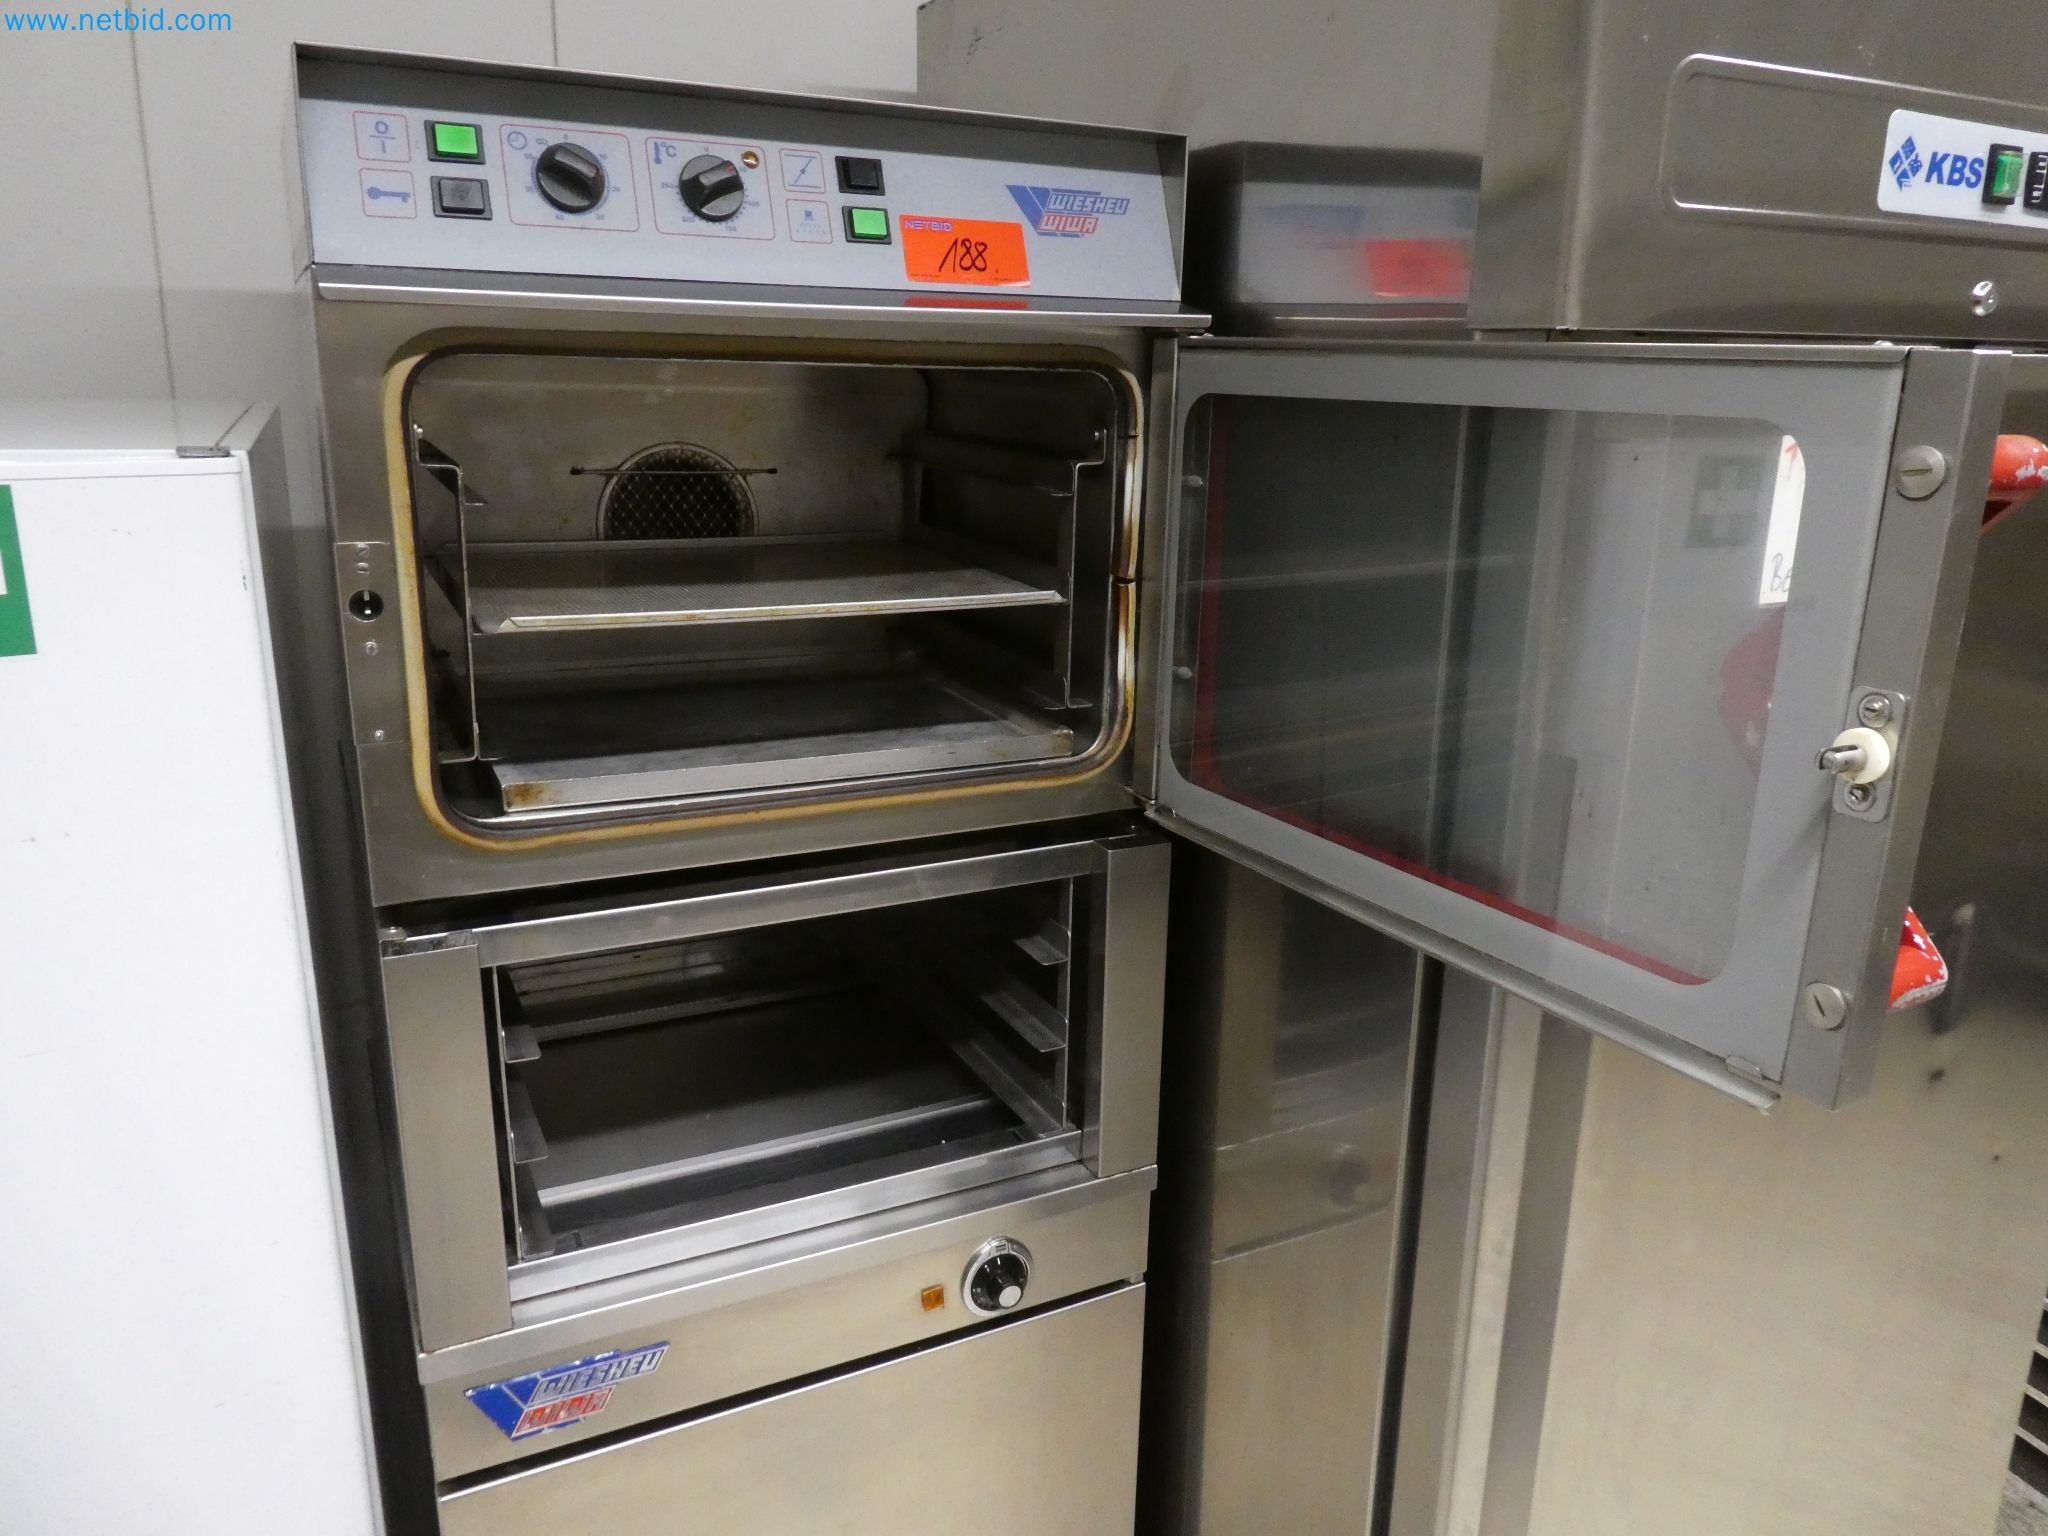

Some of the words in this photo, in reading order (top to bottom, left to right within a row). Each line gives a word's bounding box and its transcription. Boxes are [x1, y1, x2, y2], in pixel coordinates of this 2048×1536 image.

[1925, 151, 1984, 188] KBS
[1046, 192, 1128, 213] WIESHEU
[904, 220, 953, 232] NETBID
